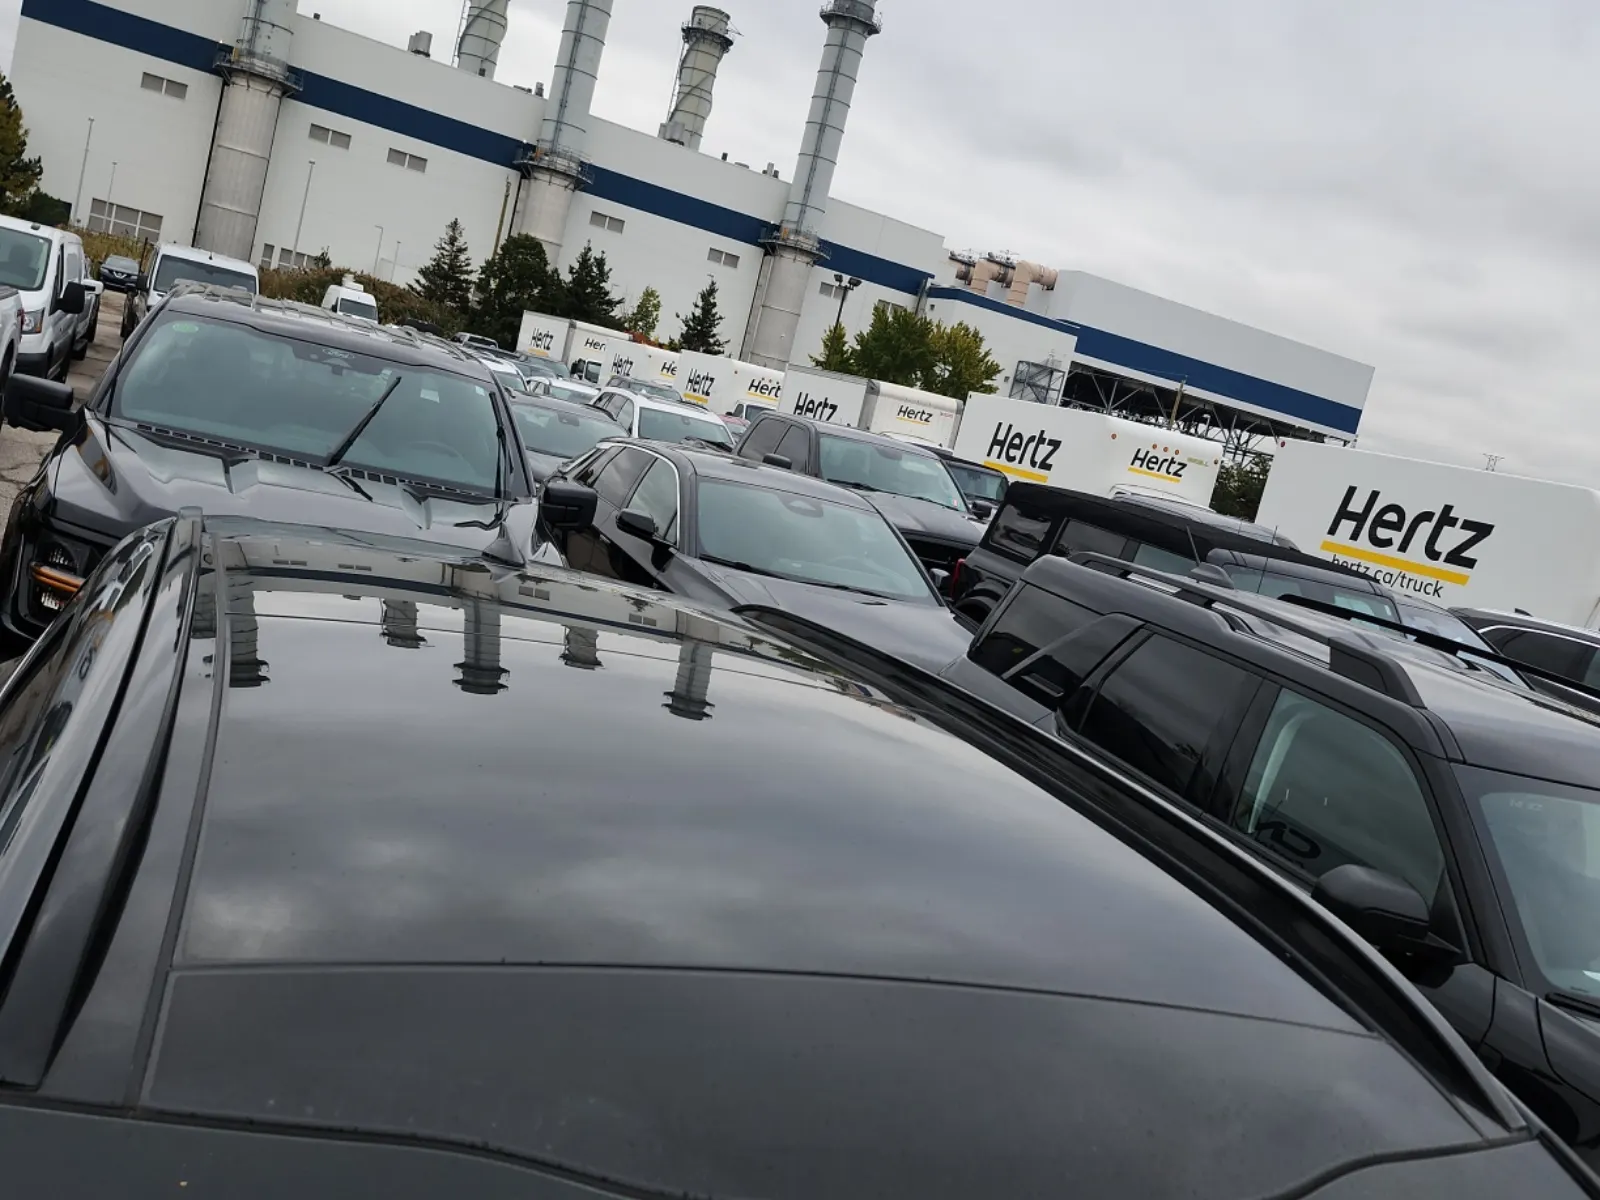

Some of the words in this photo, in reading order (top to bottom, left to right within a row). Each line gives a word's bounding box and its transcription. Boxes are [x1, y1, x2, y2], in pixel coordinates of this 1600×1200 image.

[529, 327, 554, 350] Hertz
[611, 353, 634, 377] Hertz
[685, 368, 715, 396] Hertz
[793, 391, 838, 421] Hertz
[897, 404, 933, 423] Hertz
[986, 421, 1062, 472] Hertz
[1130, 447, 1188, 478] Hertz
[1327, 485, 1495, 569] Hertz
